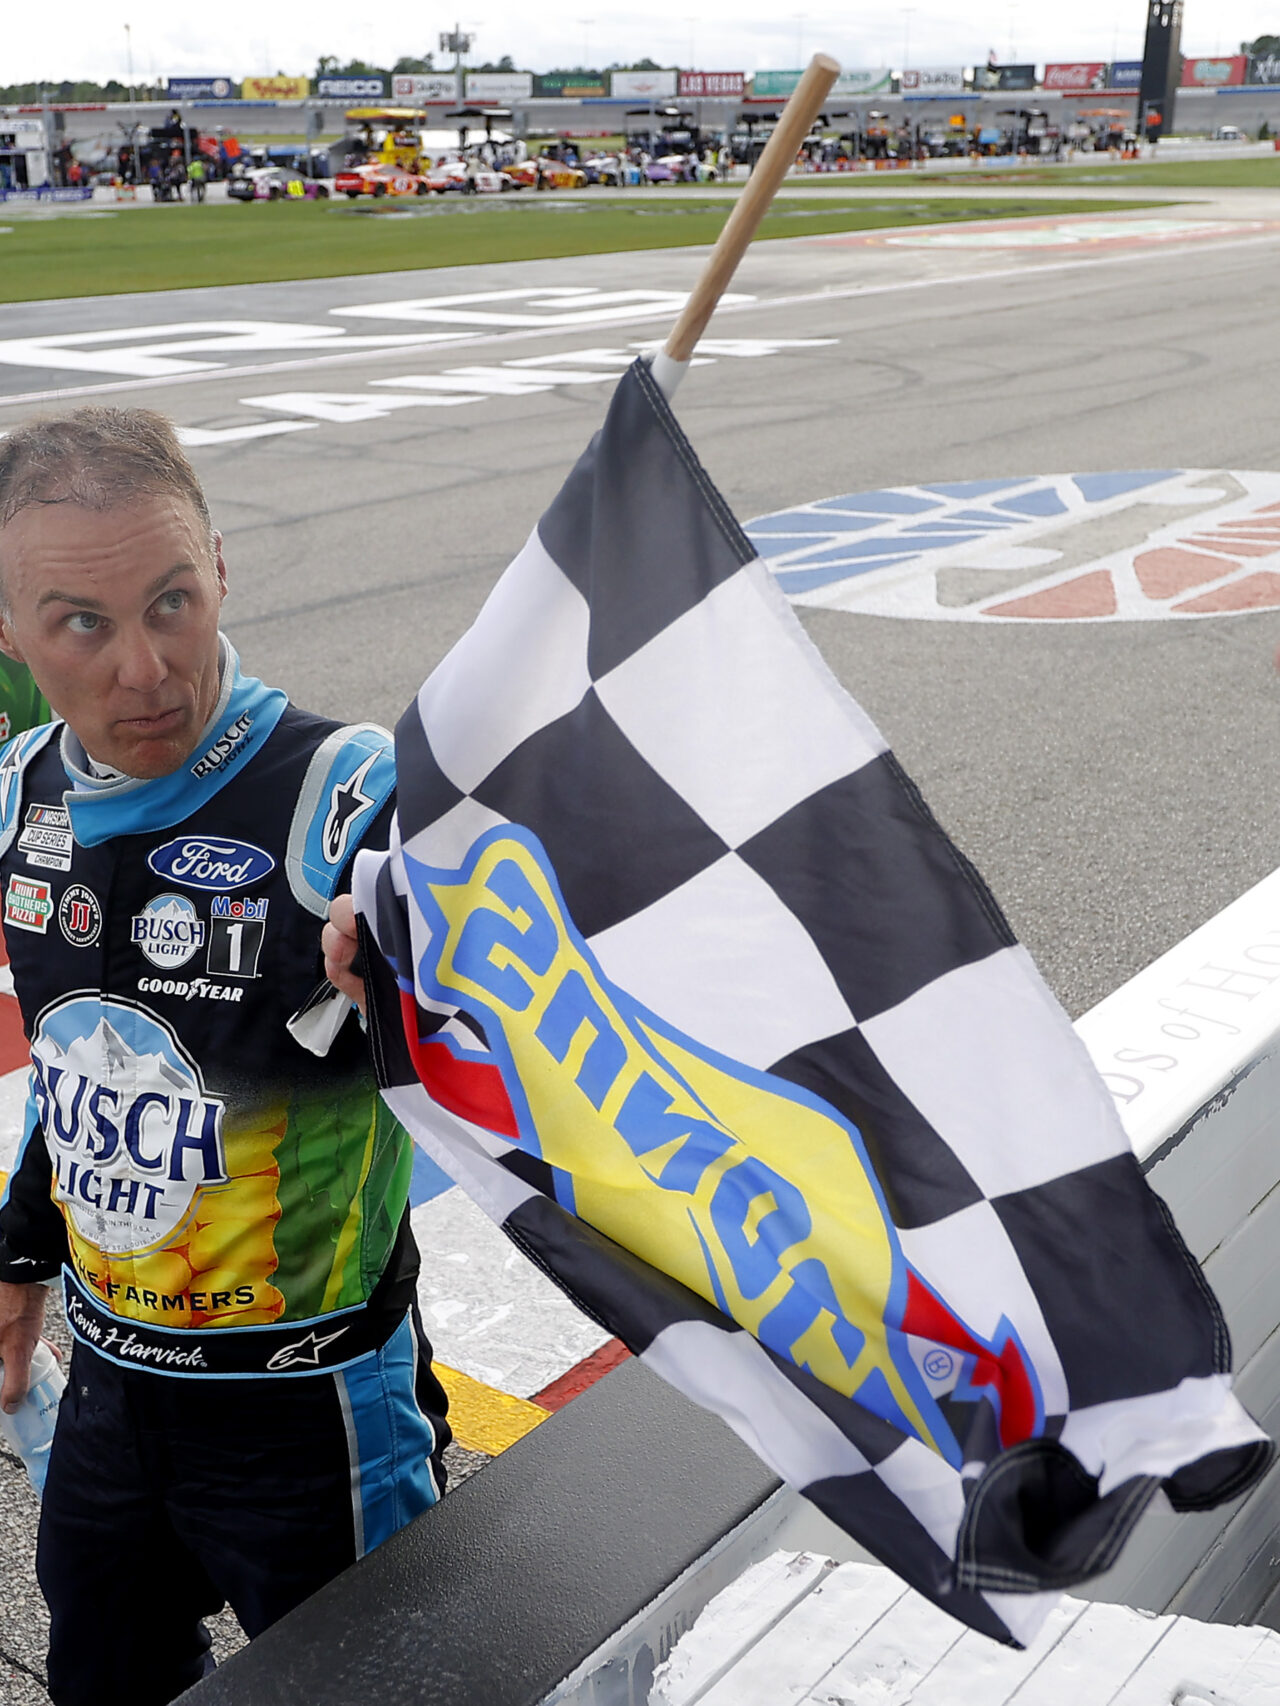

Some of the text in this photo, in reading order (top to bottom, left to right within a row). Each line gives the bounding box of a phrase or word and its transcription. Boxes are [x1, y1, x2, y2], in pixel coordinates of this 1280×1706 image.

[681, 75, 703, 91] LAS
[705, 75, 744, 91] VEGAS
[27, 829, 67, 848] CUP SERIES
[34, 855, 63, 868] CHAMPION
[172, 841, 250, 884] Ford
[14, 882, 39, 899] HUNT
[11, 907, 36, 924] PIZZA
[69, 901, 90, 933] JJ
[211, 896, 269, 919] Mobil
[132, 917, 204, 946] BUSCH
[148, 942, 189, 957] LIGHT
[226, 923, 243, 971] 1
[137, 977, 244, 1001] GOODYEAR
[57, 1153, 164, 1219] LIGHT
[106, 1282, 255, 1312] FARMERS
[68, 1296, 203, 1366] Kevin Harvick
